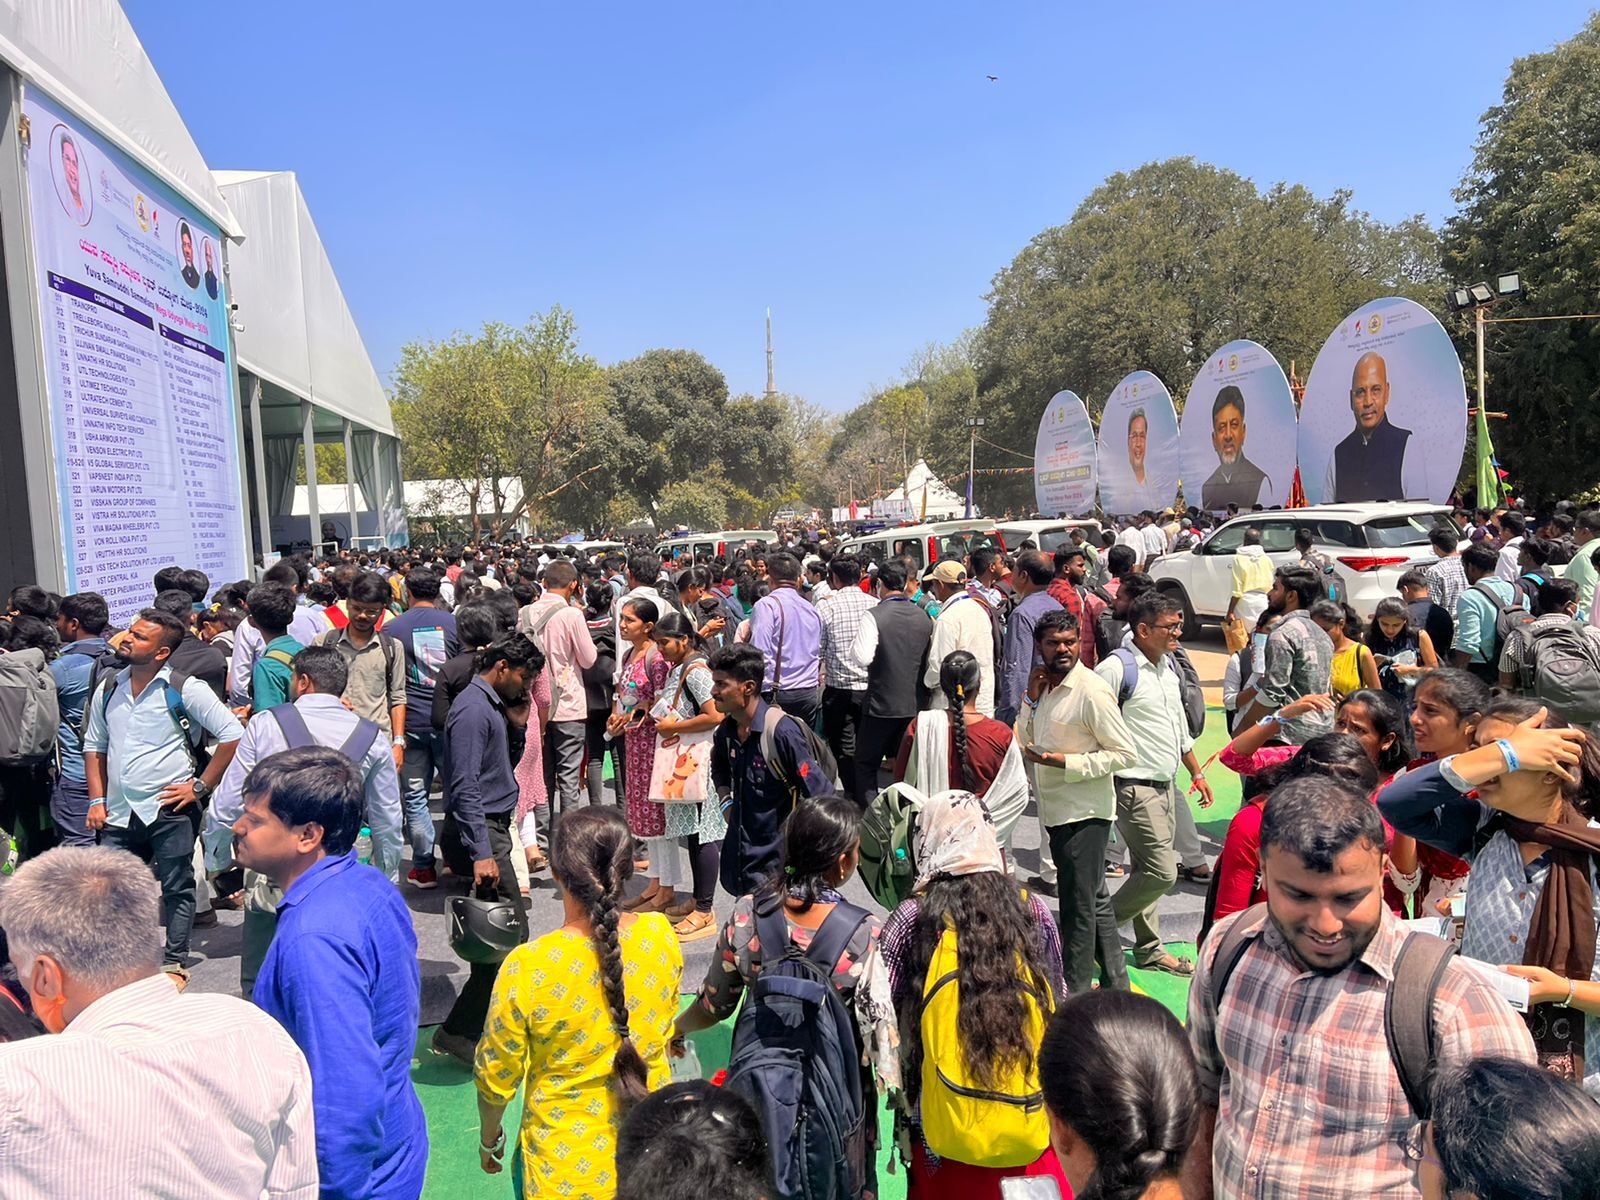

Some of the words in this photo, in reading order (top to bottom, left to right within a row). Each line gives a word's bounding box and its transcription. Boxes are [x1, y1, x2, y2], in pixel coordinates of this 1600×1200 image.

[85, 264, 101, 280] Yuva
[101, 384, 128, 397] TECHNOLOGY
[81, 392, 108, 405] ULTRATECH
[110, 398, 125, 408] CEMENT
[82, 406, 109, 418] UNIVERSAL
[85, 431, 99, 441] USHA
[86, 445, 106, 455] VENSON
[106, 447, 127, 457] ELECTRIC
[94, 459, 114, 468] GLOBAL
[114, 461, 134, 470] SERVICES
[89, 484, 106, 493] VARUN
[106, 485, 126, 493] MOTORS
[91, 511, 109, 520] VISTRA
[117, 510, 141, 519] SOLUTIONS
[92, 524, 104, 533] VIVA
[94, 537, 105, 546] VON
[105, 536, 118, 545] ROLL
[118, 535, 130, 544] INDIA
[131, 534, 139, 542] PVT
[116, 548, 122, 556] HR
[123, 546, 147, 556] SOLUTIONS
[106, 561, 119, 571] TECH
[120, 558, 141, 569] SOLUTION
[96, 576, 106, 585] VST
[107, 572, 128, 584] CENTRAL
[118, 583, 145, 594] PNEUMATICS
[118, 596, 137, 607] MANQUE
